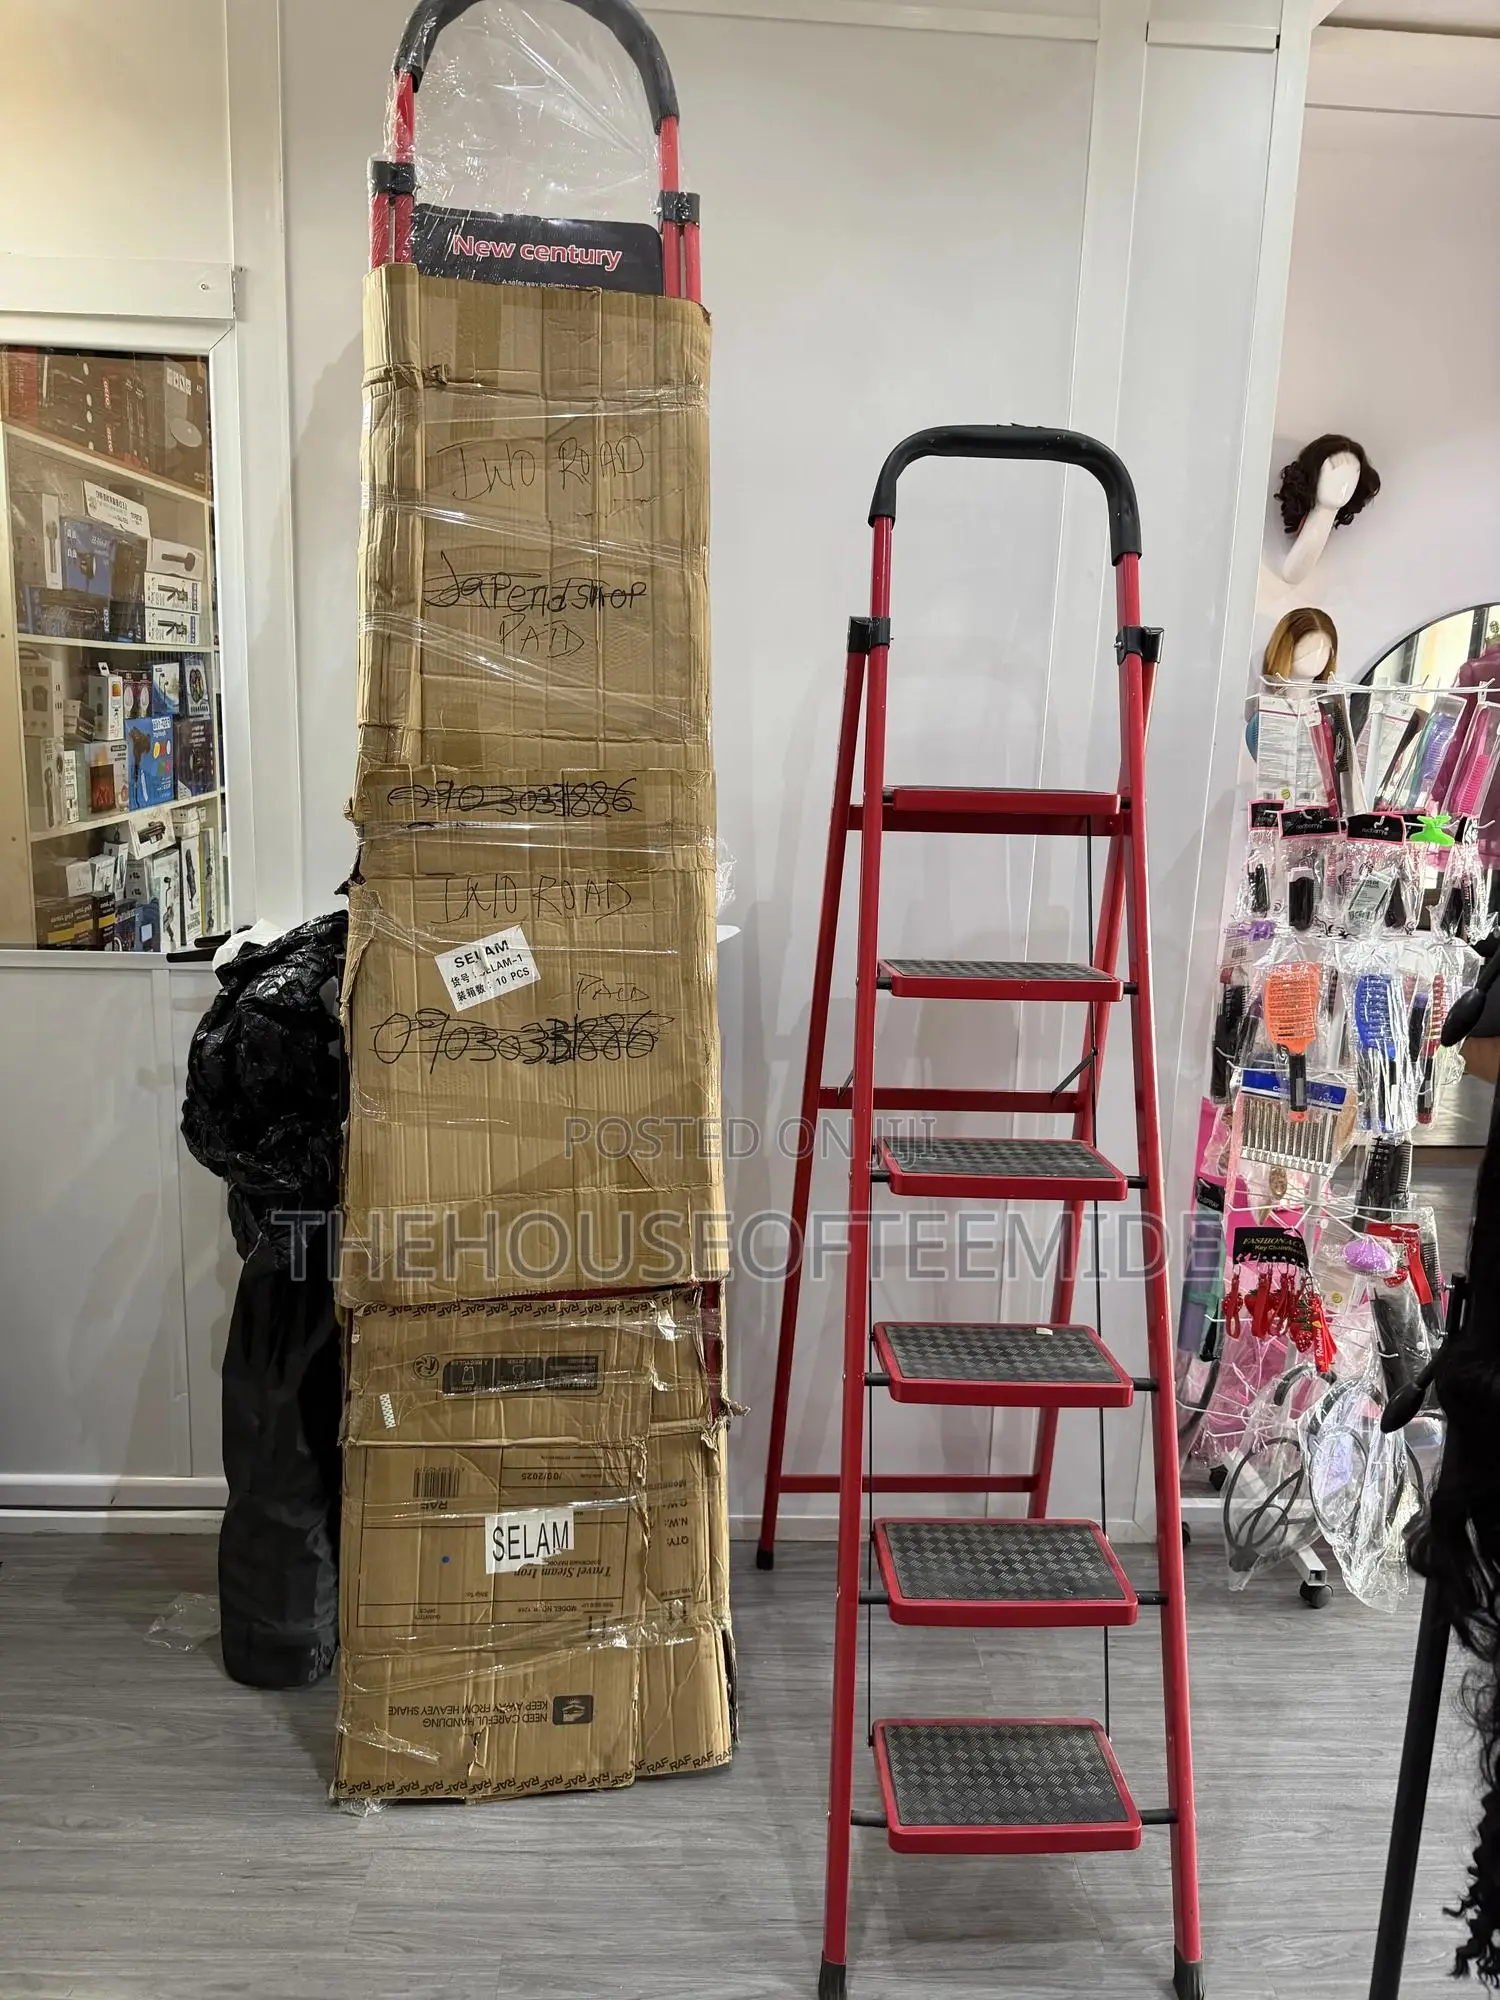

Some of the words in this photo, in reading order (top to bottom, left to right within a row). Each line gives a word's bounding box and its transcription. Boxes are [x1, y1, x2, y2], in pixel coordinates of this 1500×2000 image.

[452, 234, 516, 259] New
[520, 242, 622, 272] century
[500, 613, 585, 659] PAID
[496, 975, 508, 986] 10
[510, 967, 530, 981] PCS
[493, 1520, 569, 1562] SELAM
[541, 1566, 575, 1578] Steam
[576, 1565, 612, 1578] Travel
[388, 1706, 420, 1716] SHAKE
[421, 1705, 460, 1716] HEAVEY
[463, 1703, 490, 1715] FROM
[525, 1700, 548, 1711] KEEP
[479, 1714, 520, 1725] CAREFUL
[522, 1713, 548, 1723] NEED
[647, 1756, 670, 1774] RAF
[669, 1753, 692, 1771] RAF
[692, 1750, 715, 1768] RAF
[492, 1777, 517, 1793] RAF
[516, 1776, 539, 1792] RAF
[539, 1774, 563, 1790] RAF
[564, 1773, 587, 1789] RAF
[587, 1772, 610, 1787] RAF
[610, 1770, 633, 1786] RAF
[348, 1780, 371, 1795] RAF
[372, 1780, 395, 1795] RAF
[396, 1780, 420, 1795] RAF
[420, 1780, 444, 1795] RAF
[444, 1779, 468, 1795] RAF
[468, 1778, 493, 1794] RAF
